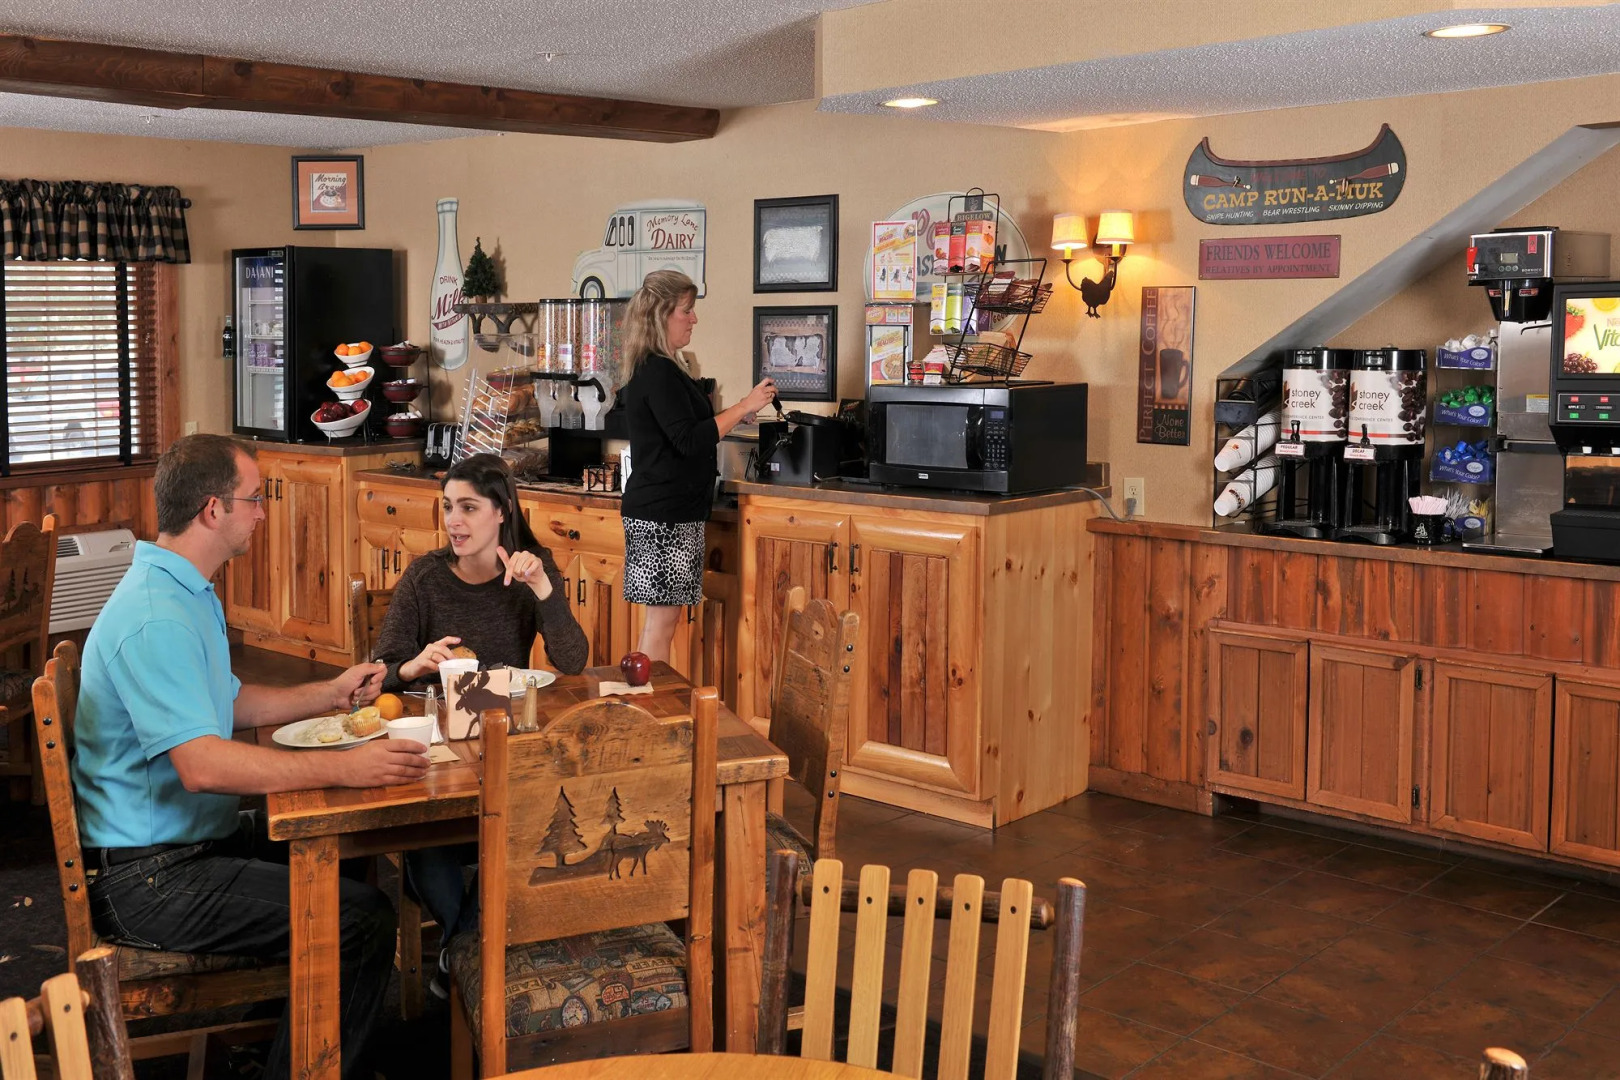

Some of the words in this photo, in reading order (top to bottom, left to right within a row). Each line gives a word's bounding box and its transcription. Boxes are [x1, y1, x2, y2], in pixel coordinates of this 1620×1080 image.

[315, 173, 348, 185] Morning
[1203, 191, 1260, 210] CAMP
[1264, 182, 1384, 205] RUN-A-MUK
[1262, 208, 1281, 217] BEAR
[1282, 205, 1320, 215] WRESTLING
[1328, 203, 1354, 212] SKINNY
[1355, 201, 1384, 210] DIPPING
[957, 212, 991, 222] BIGELOW
[1206, 212, 1225, 221] SNIPE
[1225, 210, 1254, 219] HUNTING
[646, 213, 679, 232] Memory
[681, 213, 699, 232] Lane
[650, 228, 696, 250] DAIRY
[1206, 244, 1260, 261] FRIENDS
[1264, 242, 1331, 260] WELCOME
[245, 264, 274, 280] DASANI
[1205, 265, 1250, 274] RELATIVES
[1253, 265, 1264, 274] BY
[1267, 263, 1332, 273] APPOINTMENT
[439, 275, 458, 286] DRINK
[431, 287, 465, 320] Milk
[1142, 289, 1158, 356] COFFEE
[1444, 353, 1459, 361] What's
[1459, 356, 1469, 364] Your
[1291, 388, 1321, 401] stoney
[1359, 389, 1390, 402] stoney
[1138, 367, 1155, 441] PERFECT
[1291, 398, 1316, 408] creek
[1359, 400, 1384, 411] creek
[1157, 413, 1184, 427] None
[1441, 409, 1457, 417] What's
[1457, 412, 1467, 420] Your
[1439, 465, 1455, 473] What's
